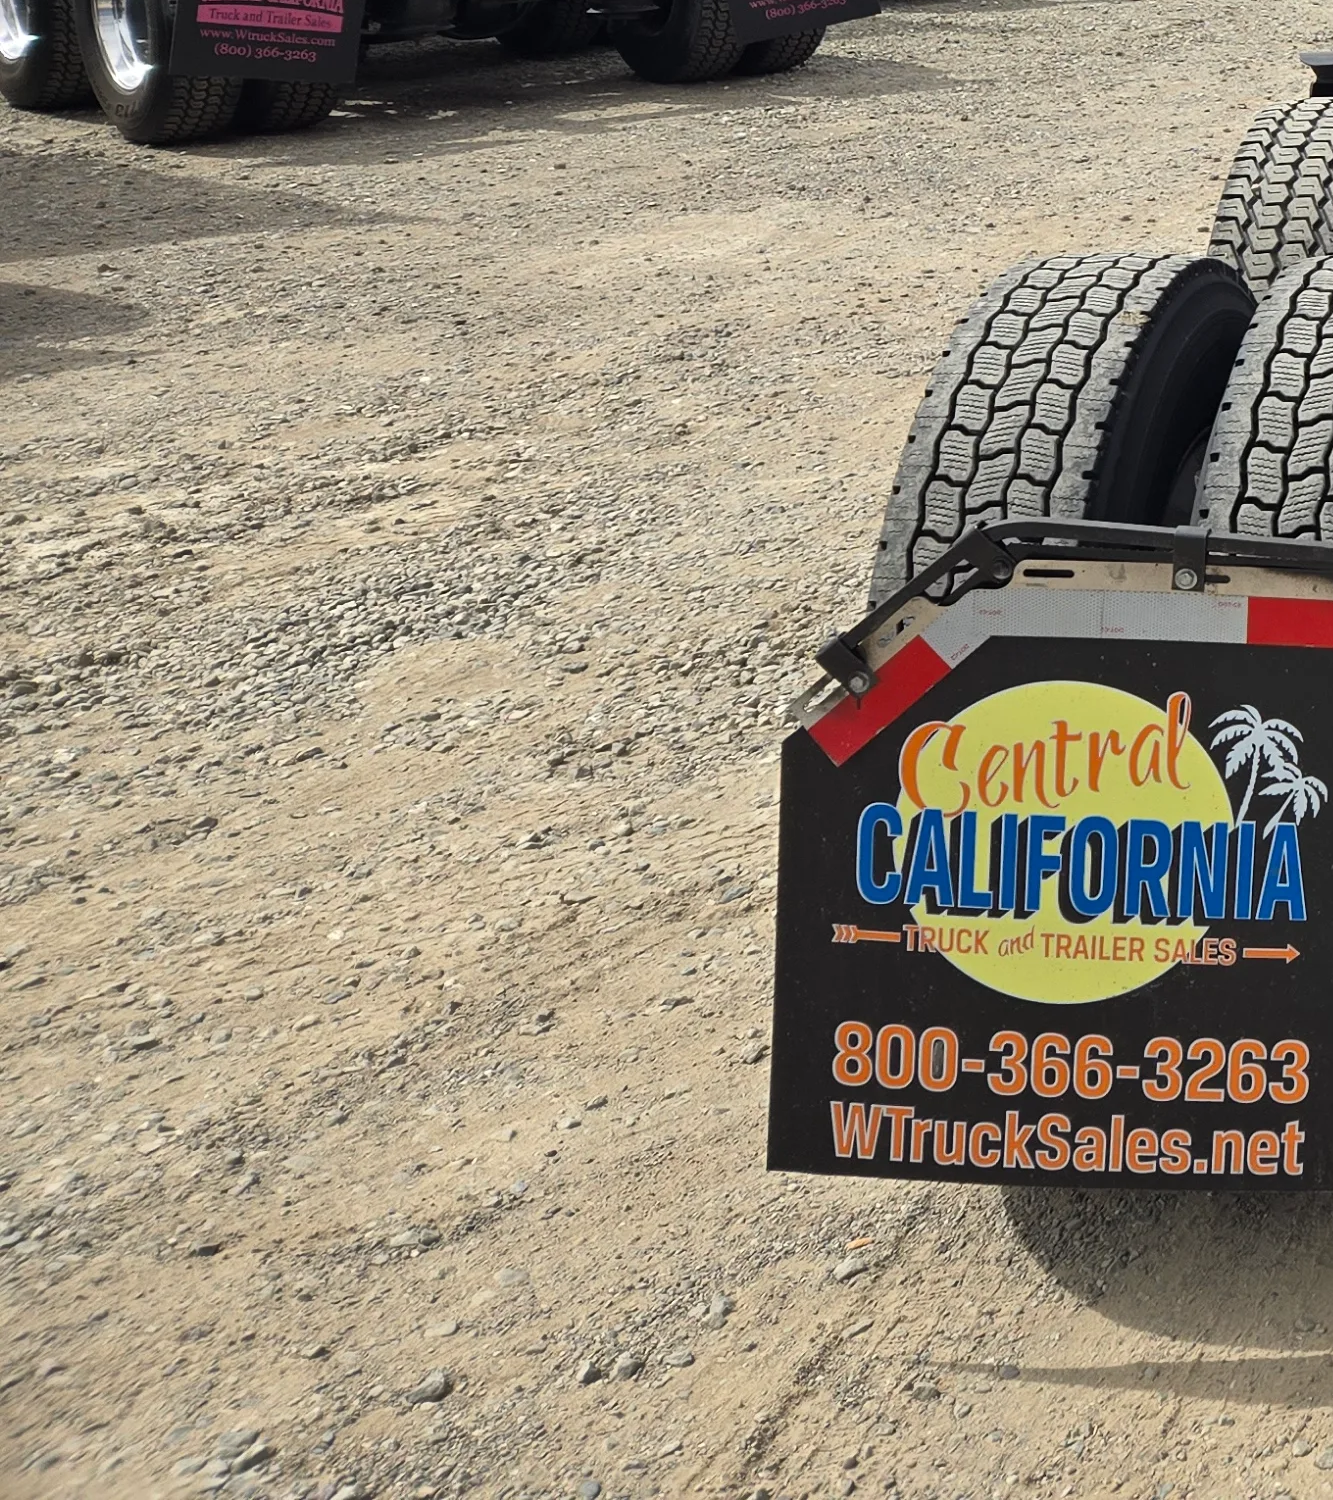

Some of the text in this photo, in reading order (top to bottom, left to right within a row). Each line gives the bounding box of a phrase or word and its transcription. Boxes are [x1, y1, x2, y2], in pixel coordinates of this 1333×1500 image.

[209, 7, 332, 29] Truck and Trailer Sales
[765, 4, 796, 20] (800)
[200, 29, 336, 47] www.WtruckSales.com
[214, 42, 317, 62] (800) 366-3263
[898, 690, 1192, 818] Central
[855, 802, 1308, 923] CALIFORNIA
[902, 923, 1237, 967] TRUCK and TRAILER SALES
[831, 1021, 1311, 1104] 800-366-3263
[830, 1100, 1306, 1176] WTruckSales.net
